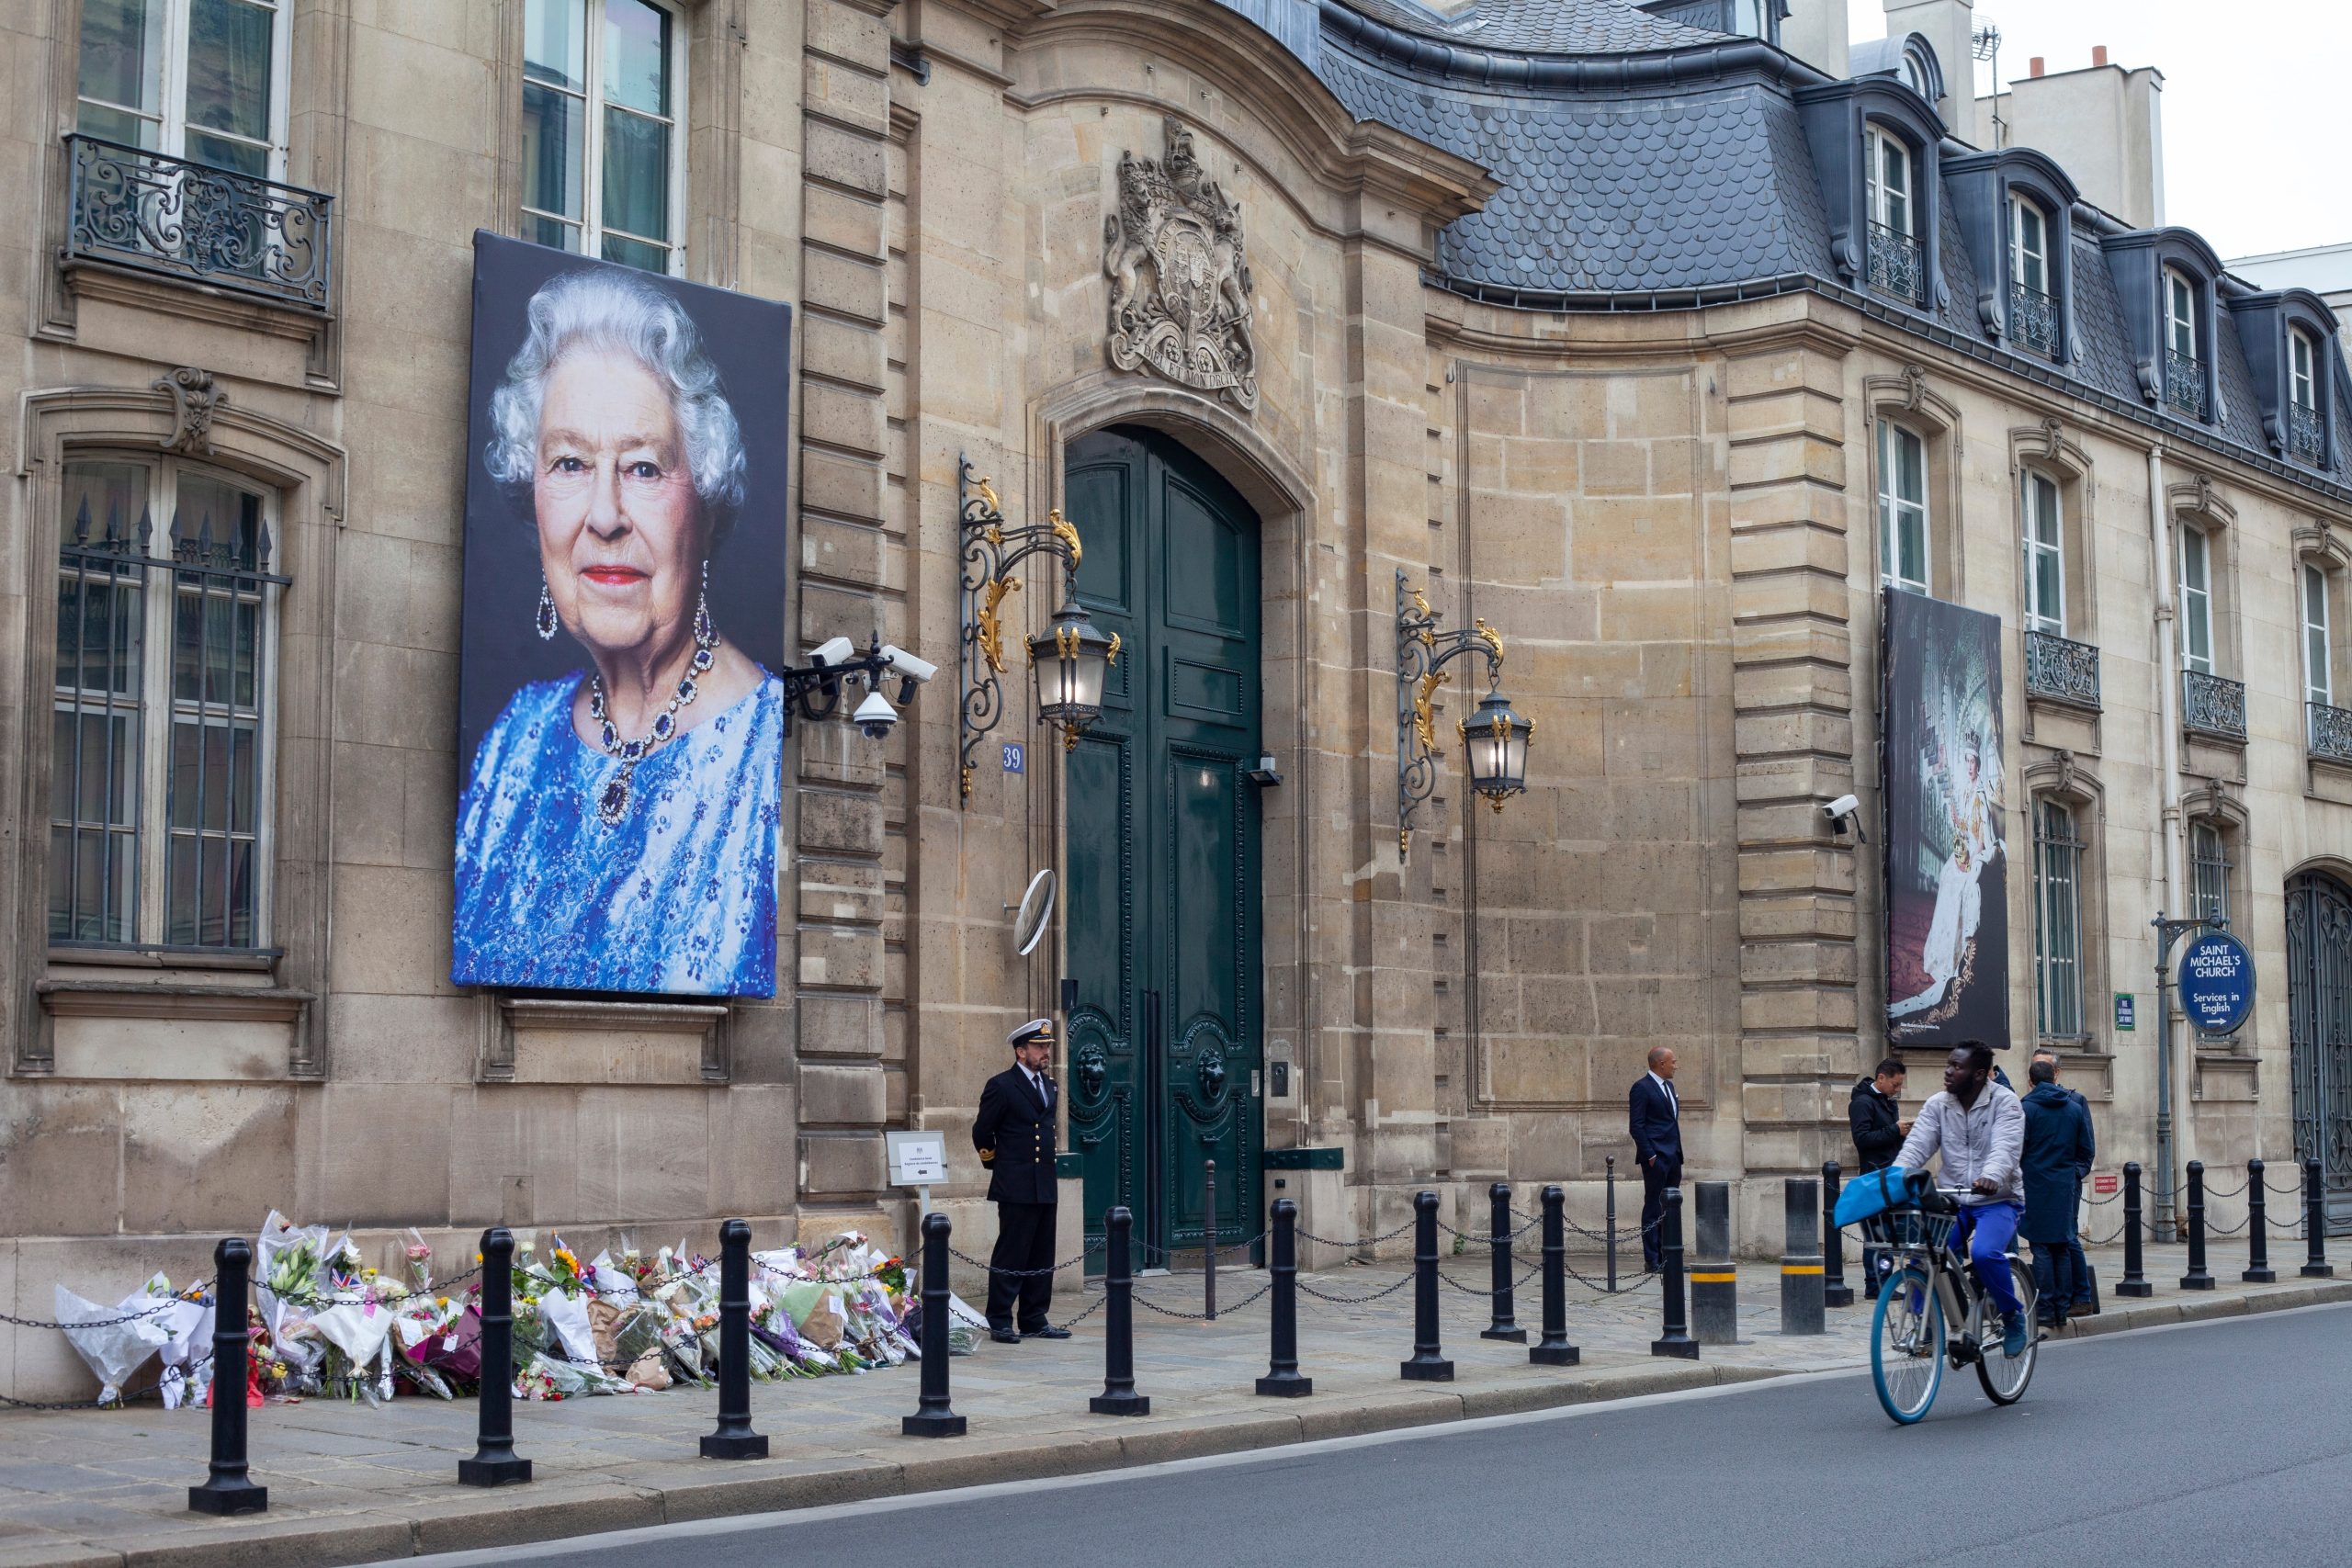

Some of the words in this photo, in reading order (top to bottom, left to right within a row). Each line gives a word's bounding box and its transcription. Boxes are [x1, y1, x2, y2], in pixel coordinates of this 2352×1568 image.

[1169, 362, 1182, 379] ET
[1185, 369, 1206, 386] MON
[1003, 747, 1021, 769] 39
[2199, 944, 2229, 956] SAINT
[2189, 955, 2241, 967] MICHAEL'S
[2195, 966, 2235, 978] CHURCH
[2193, 992, 2227, 1003] Services
[2231, 992, 2240, 1001] in
[2201, 1001, 2231, 1015] English
